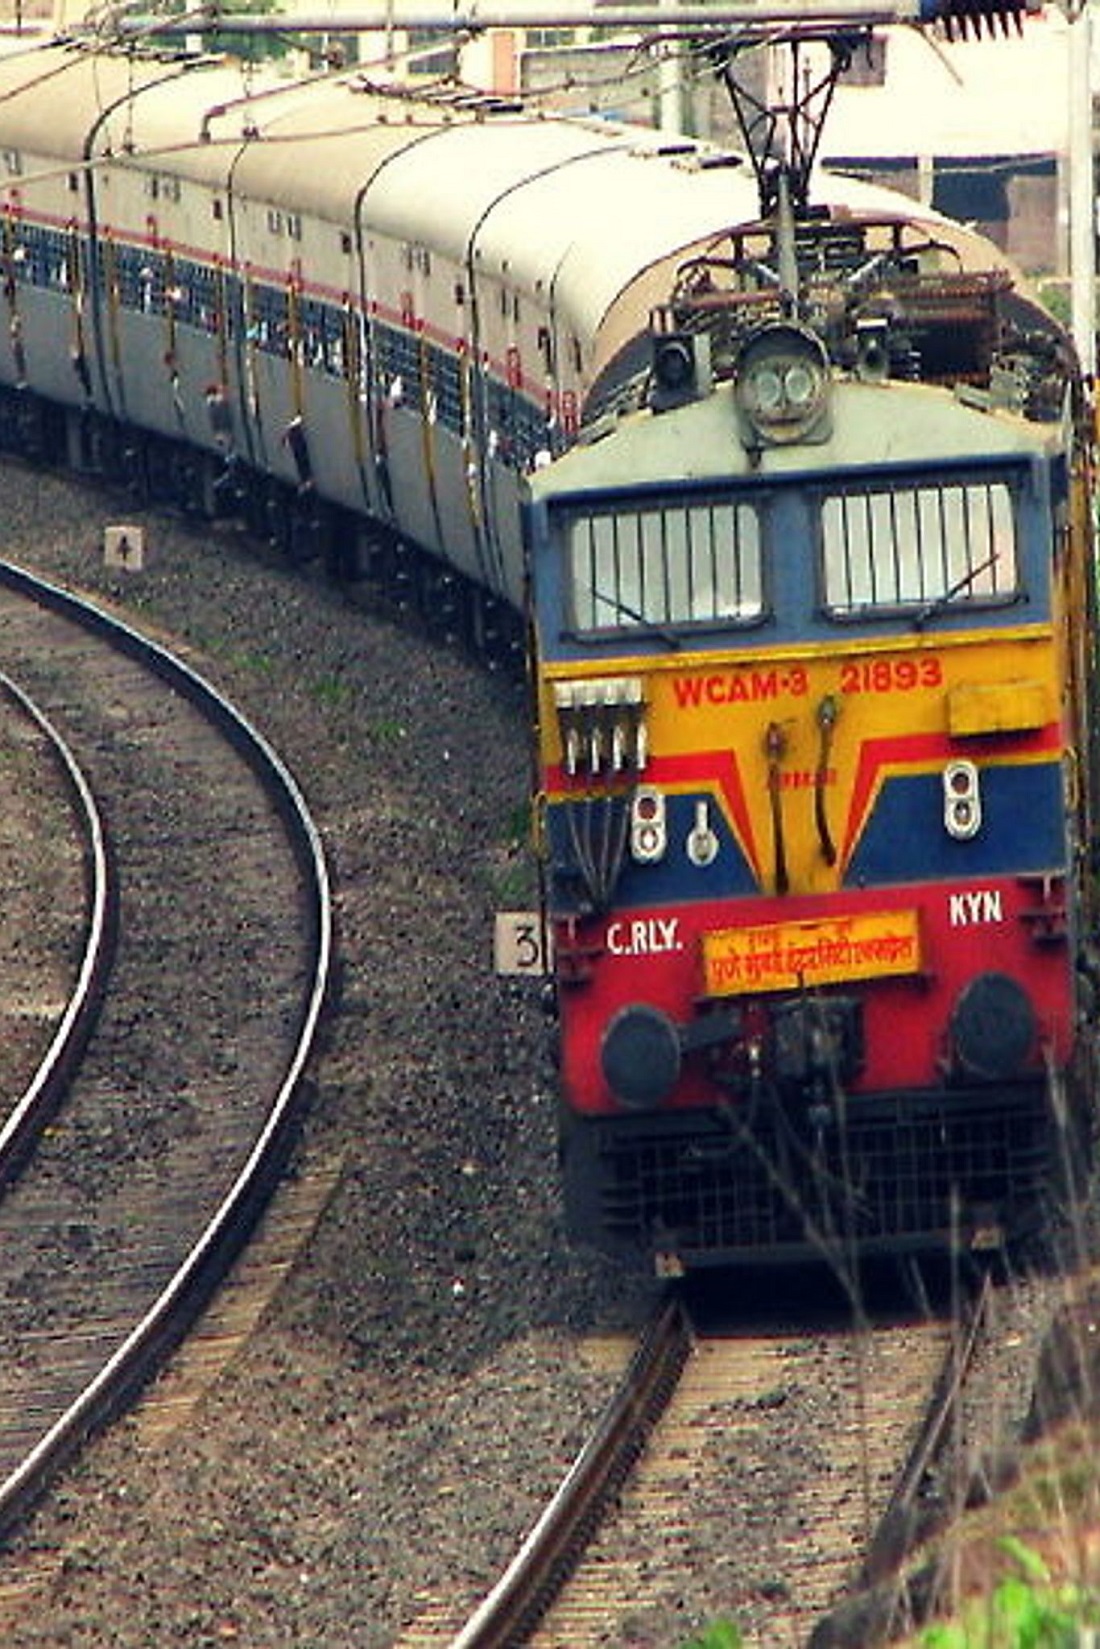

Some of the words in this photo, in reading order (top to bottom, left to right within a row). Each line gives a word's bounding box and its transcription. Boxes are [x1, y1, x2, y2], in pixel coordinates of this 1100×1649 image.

[674, 668, 808, 707] WCAM-3
[840, 657, 942, 694] 21893
[950, 890, 1002, 926] KYN
[515, 921, 540, 967] 3
[607, 918, 683, 955] C.RLY.
